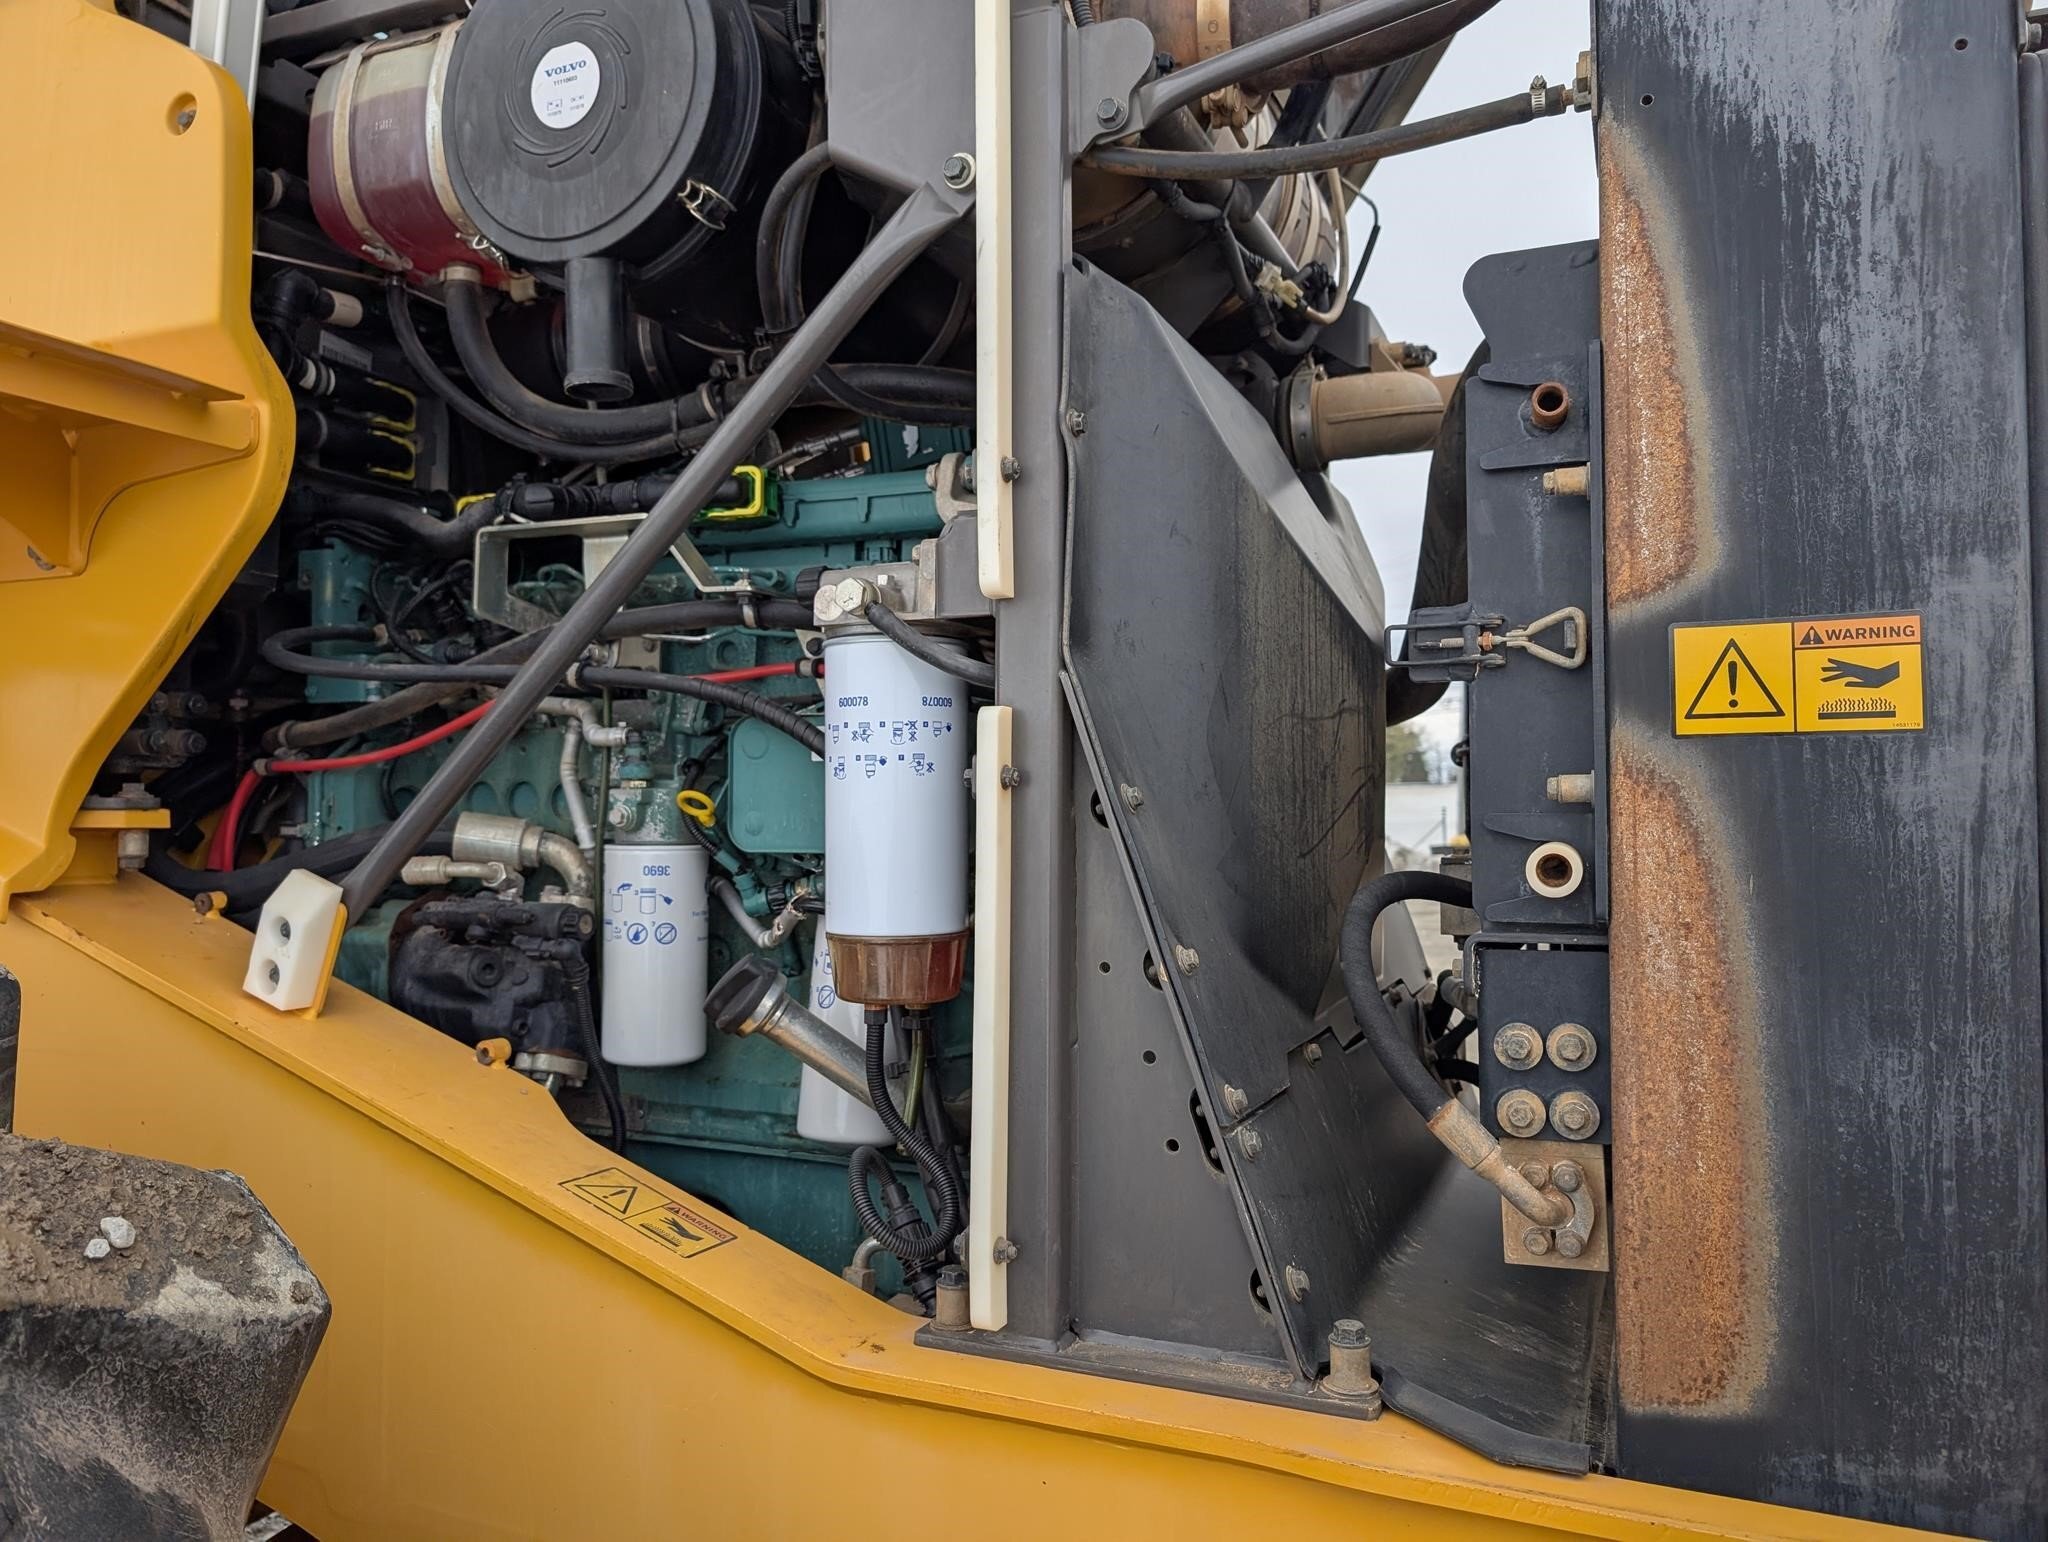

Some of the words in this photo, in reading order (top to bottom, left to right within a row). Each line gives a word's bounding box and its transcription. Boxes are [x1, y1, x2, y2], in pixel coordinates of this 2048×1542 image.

[544, 60, 586, 77] VOLVO
[1825, 624, 1916, 641] WARNING
[838, 696, 869, 708] 600078
[921, 696, 953, 708] 600078
[643, 865, 671, 876] 3690
[681, 1212, 727, 1239] WARNING
